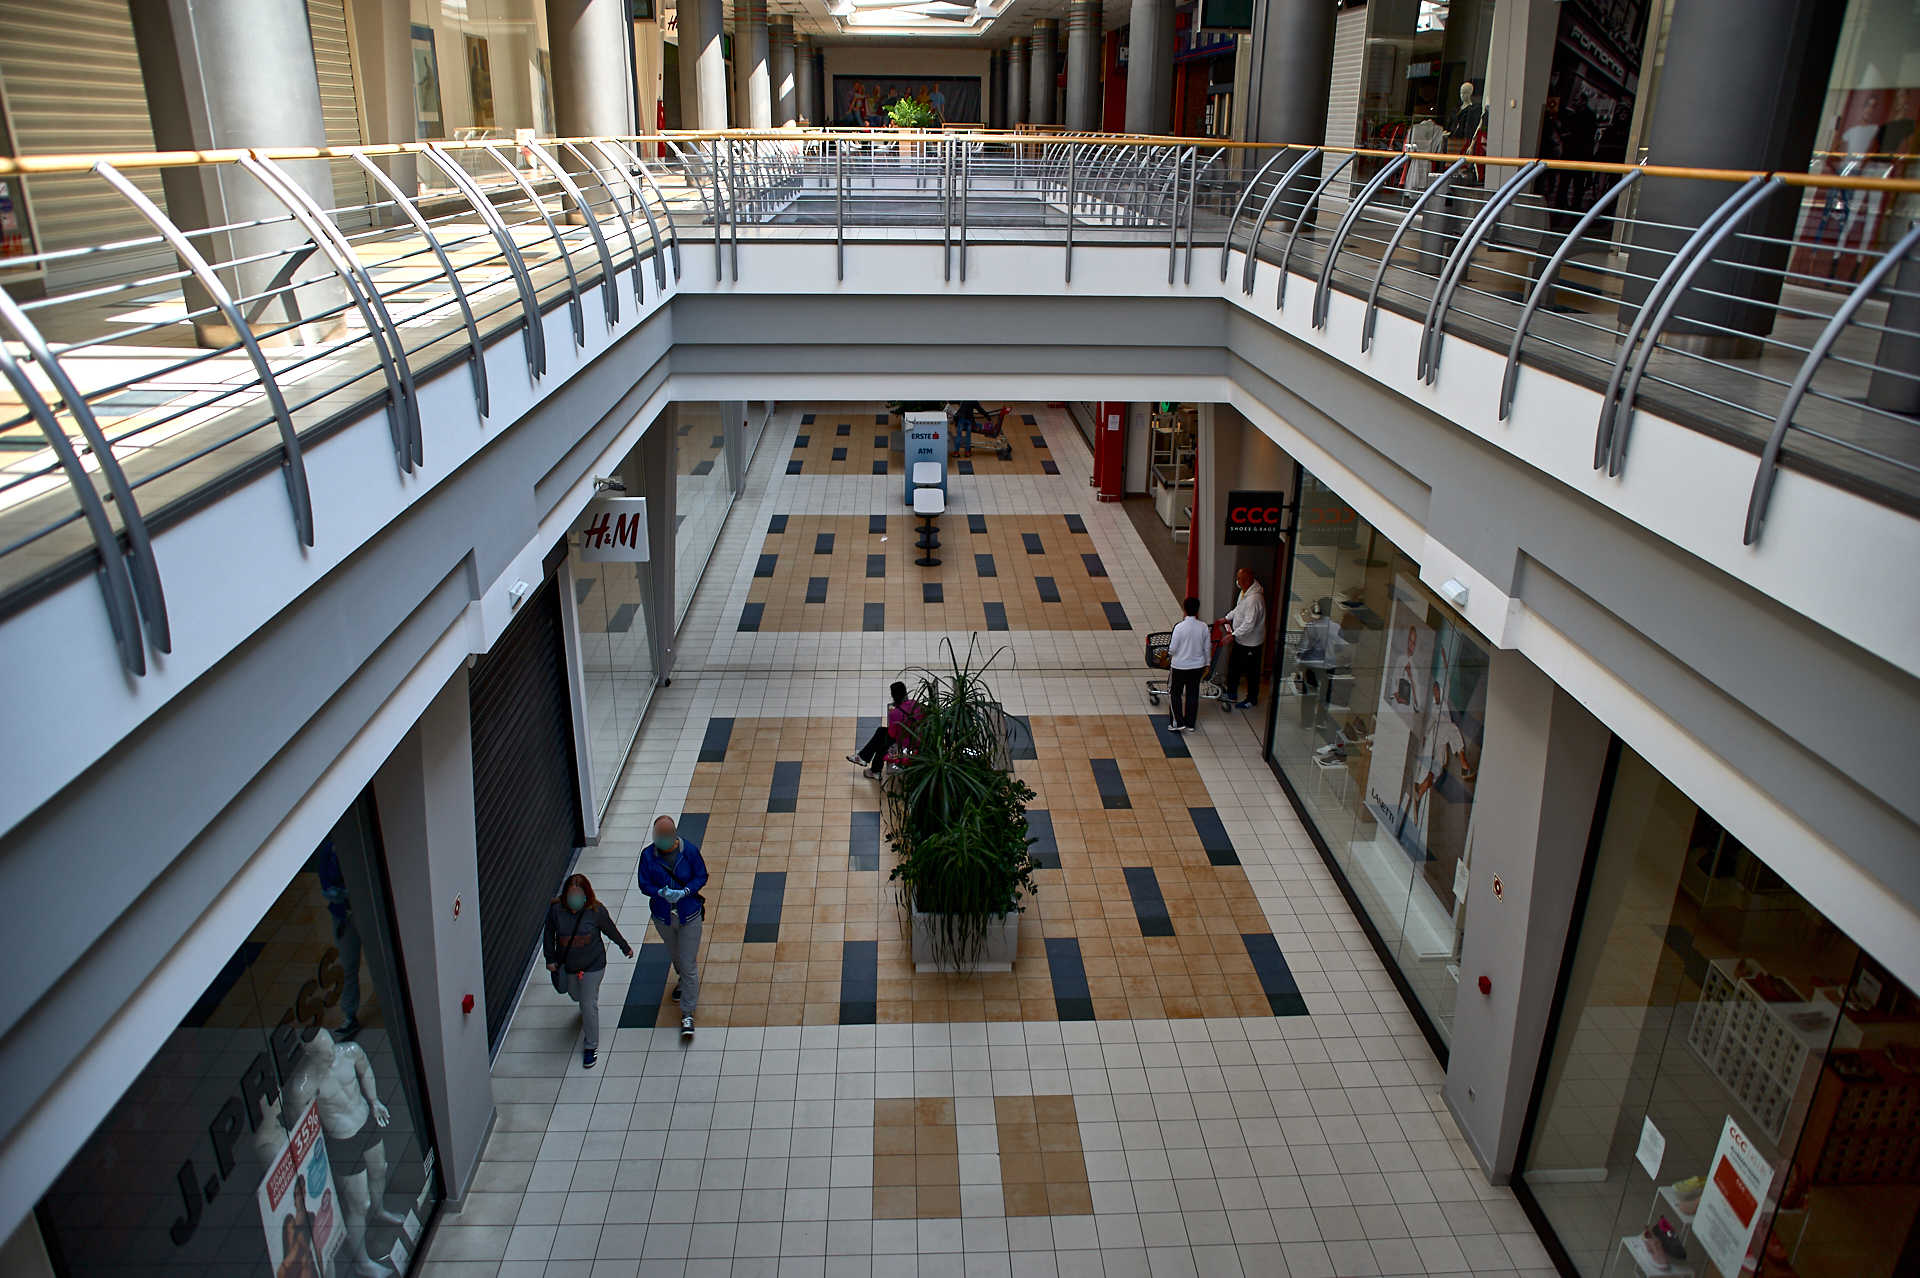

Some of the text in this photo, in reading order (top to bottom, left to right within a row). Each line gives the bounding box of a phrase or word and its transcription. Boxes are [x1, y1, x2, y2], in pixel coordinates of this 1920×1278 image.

[583, 512, 640, 549] H&M
[1231, 506, 1279, 524] CCC
[294, 1107, 319, 1152] 35%
[1730, 1127, 1747, 1153] CCC
